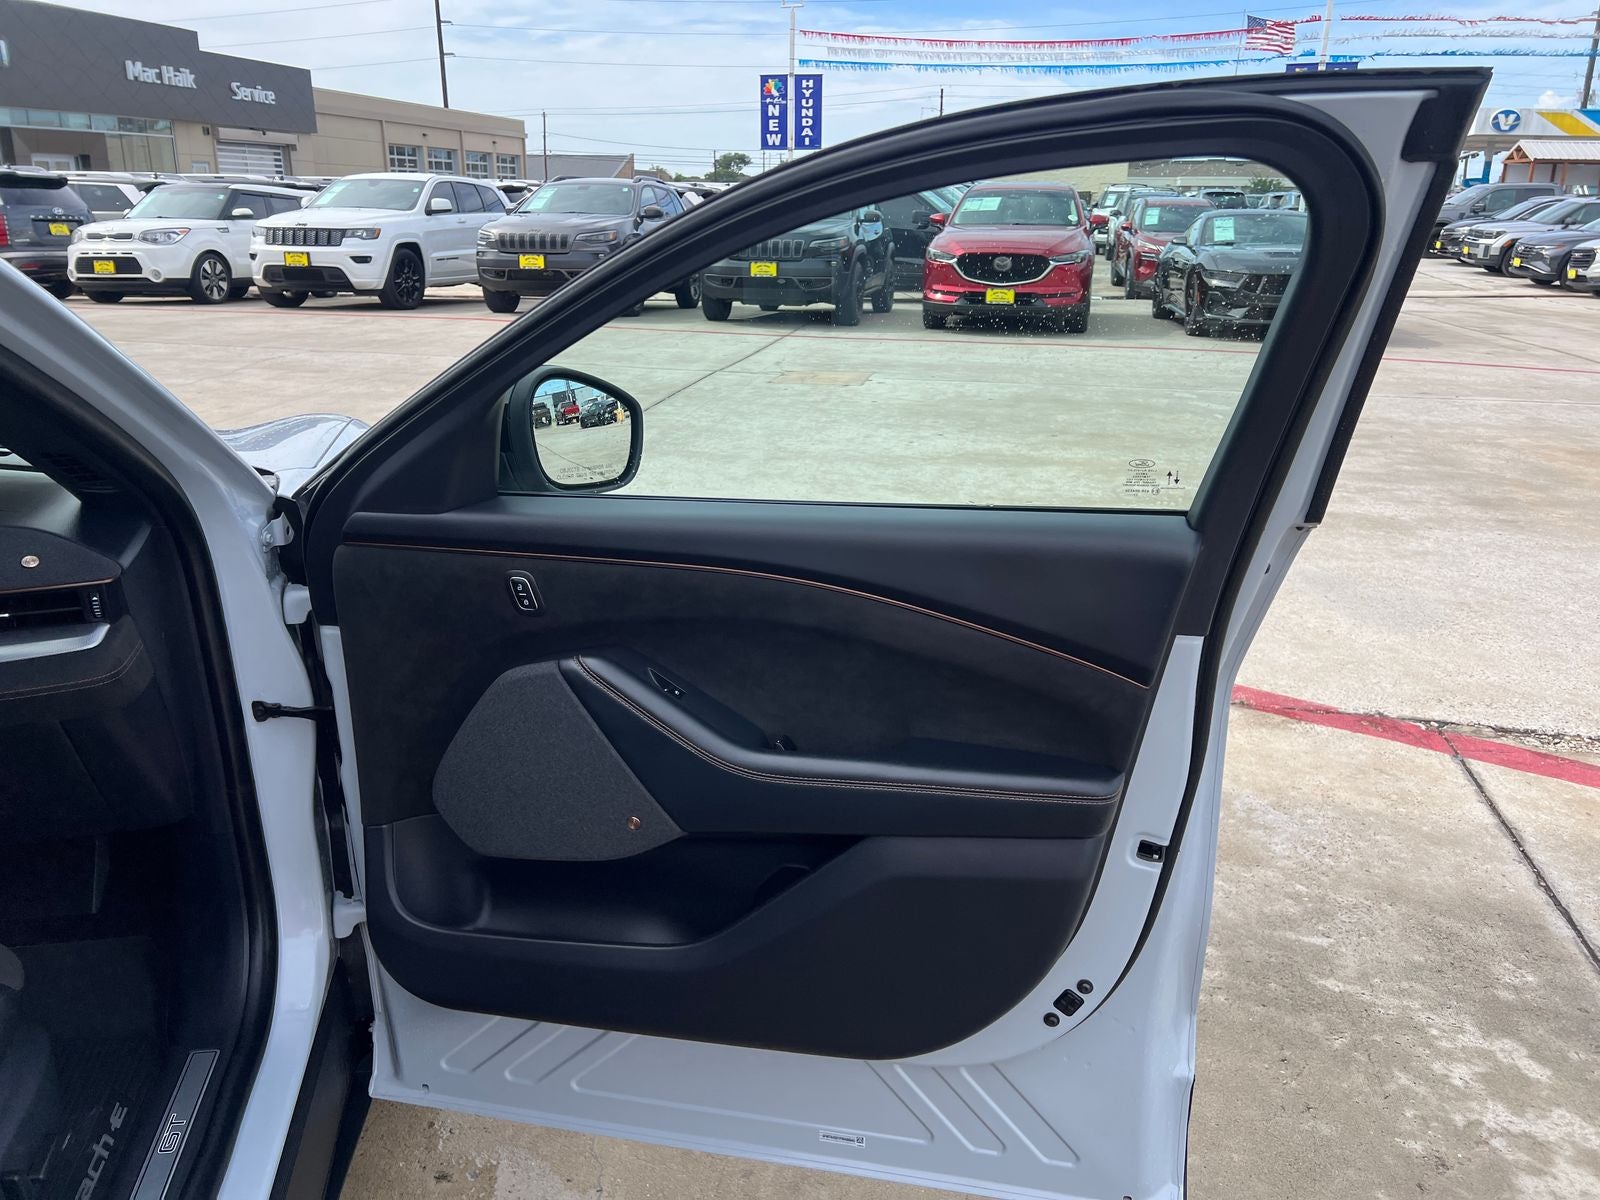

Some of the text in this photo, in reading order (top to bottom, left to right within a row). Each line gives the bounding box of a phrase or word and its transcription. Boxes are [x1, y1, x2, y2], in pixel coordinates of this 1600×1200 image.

[125, 60, 197, 89] Mac Haik
[231, 82, 276, 105] Service
[766, 104, 782, 146] NEW
[801, 79, 814, 146] HYUNDAI
[158, 1113, 186, 1153] GT
